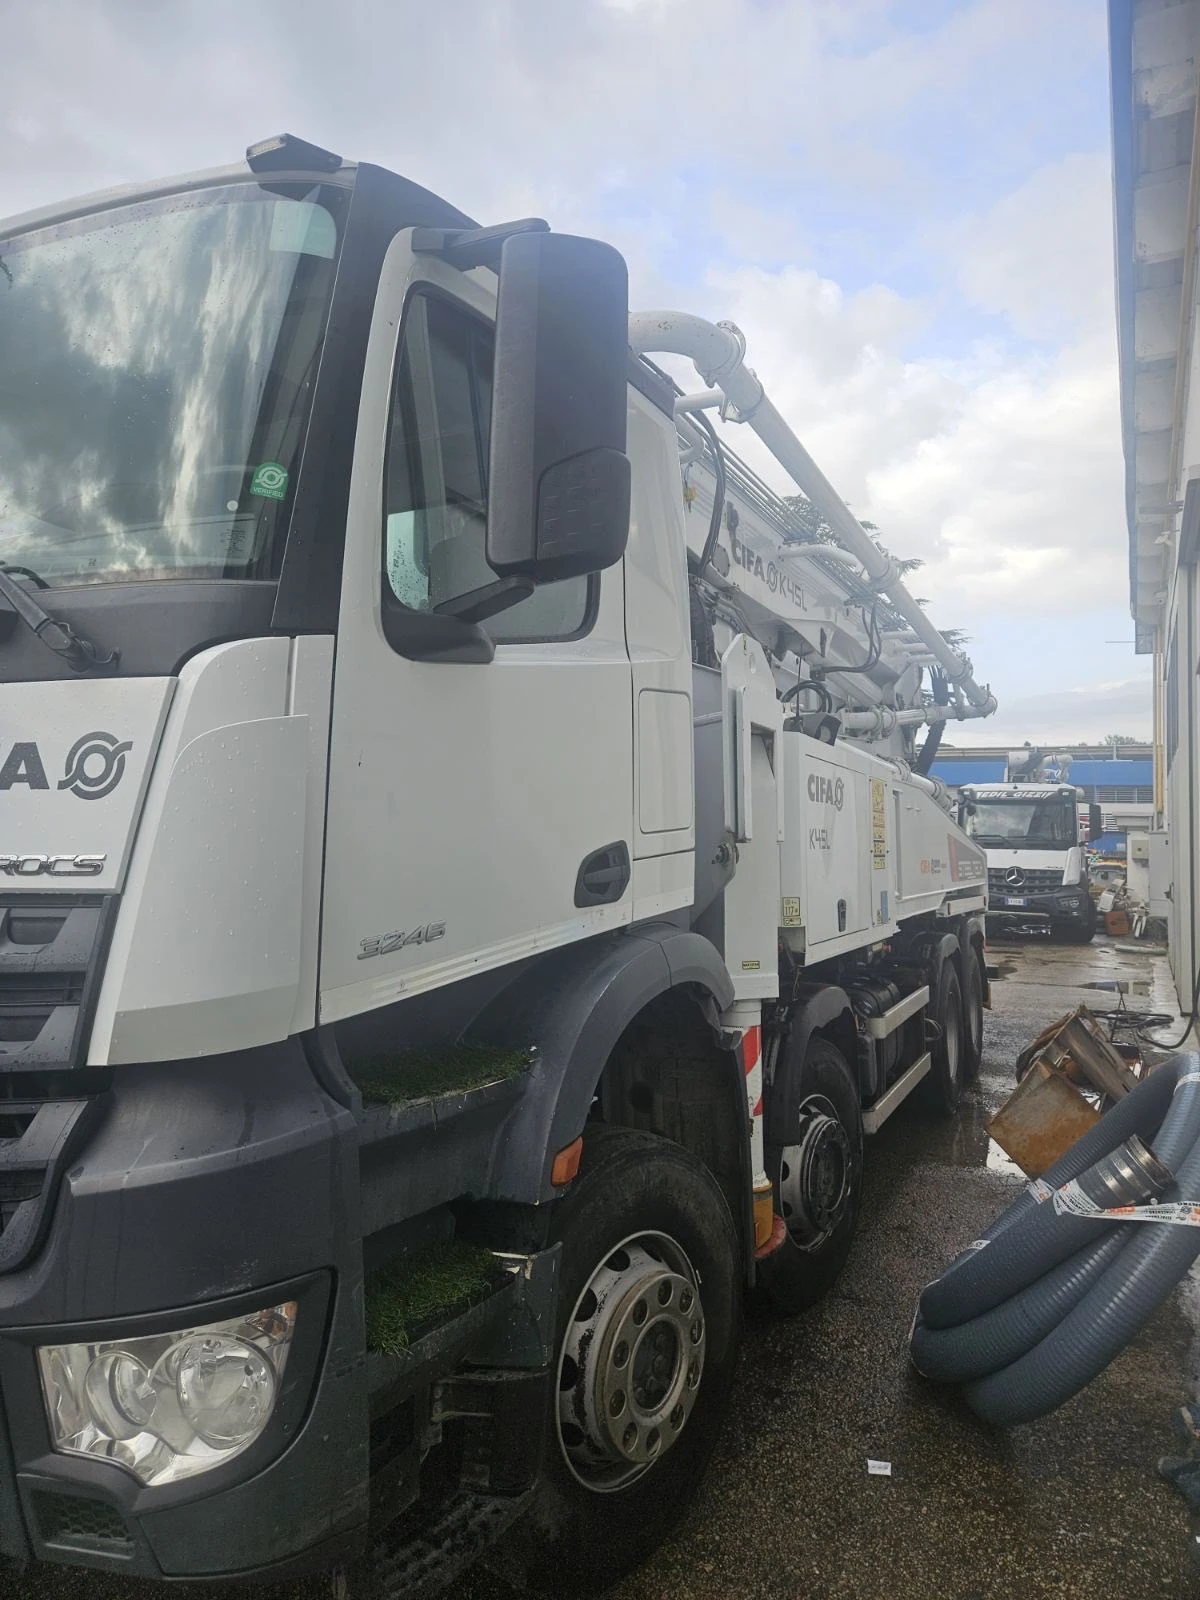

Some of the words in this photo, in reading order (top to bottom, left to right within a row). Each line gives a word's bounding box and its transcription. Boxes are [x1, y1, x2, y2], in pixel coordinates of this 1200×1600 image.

[253, 487, 284, 498] VERIFIED
[732, 538, 766, 583] CIFA
[779, 571, 808, 612] K45L
[807, 773, 835, 805] CIFA
